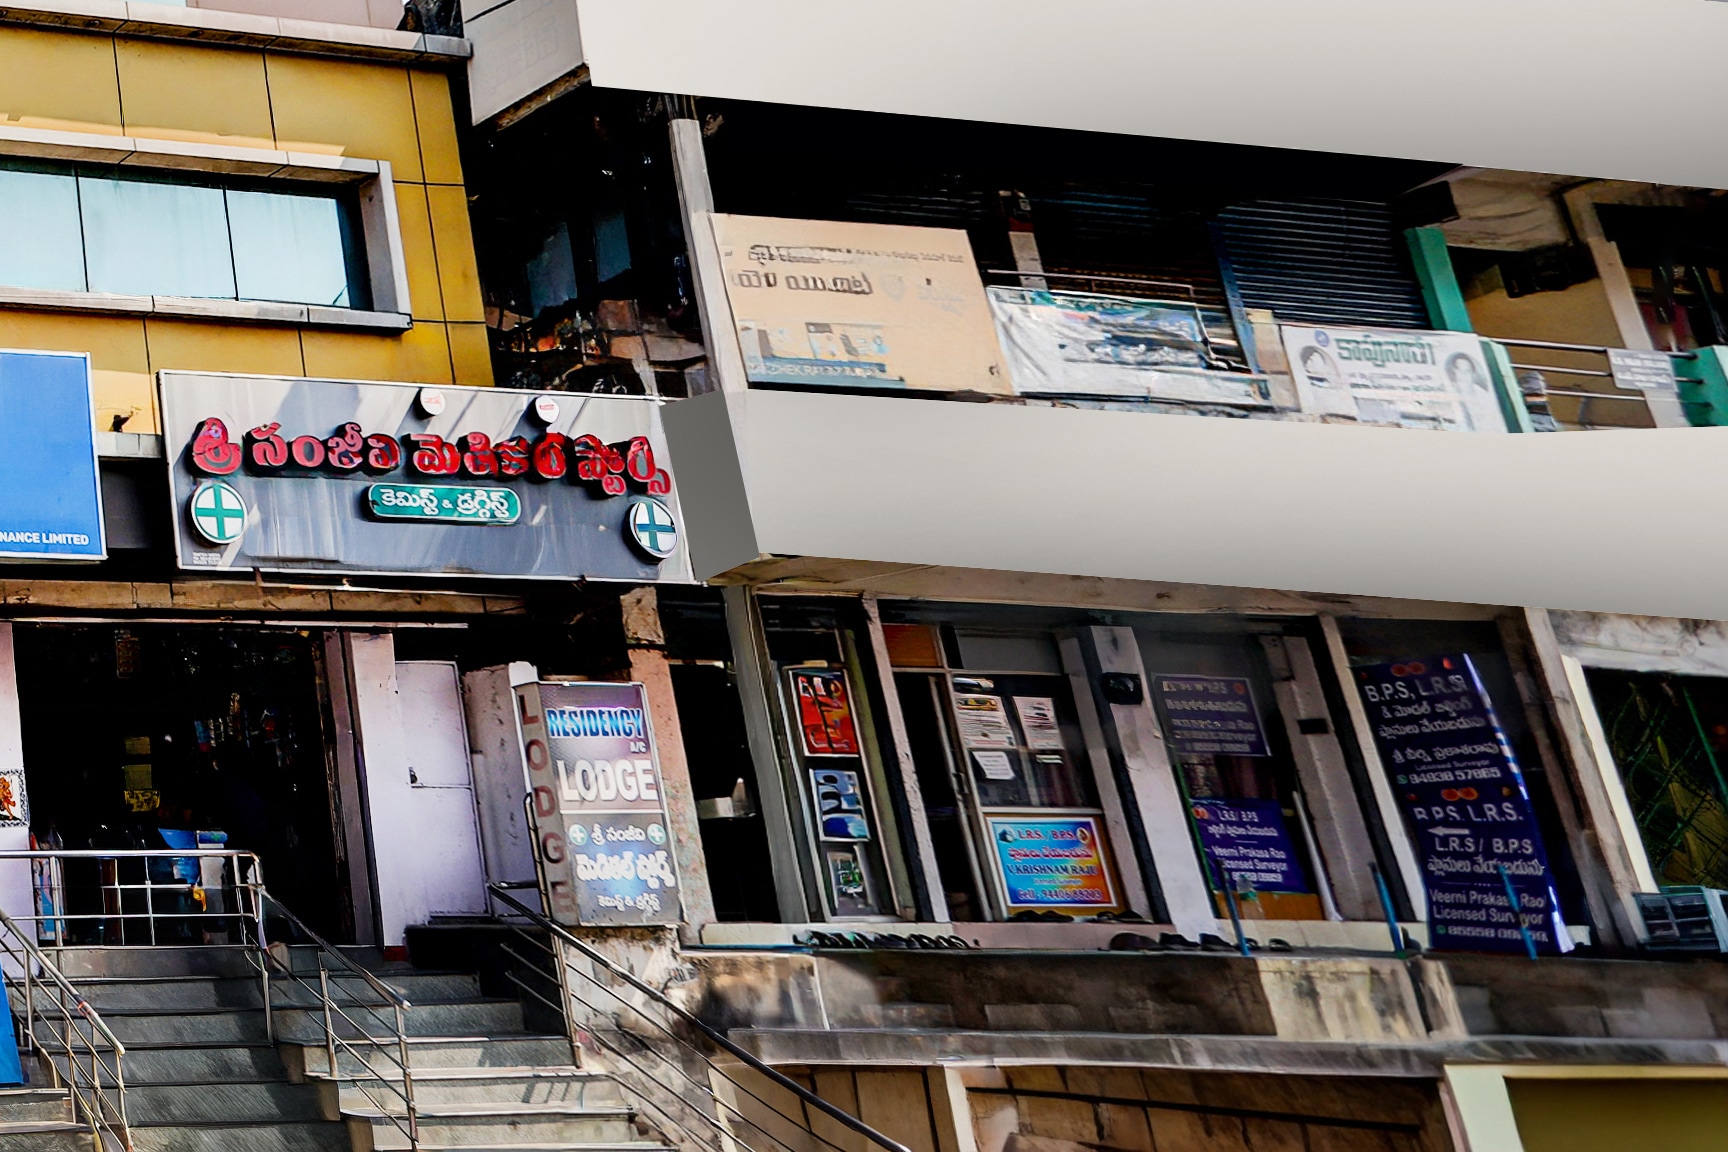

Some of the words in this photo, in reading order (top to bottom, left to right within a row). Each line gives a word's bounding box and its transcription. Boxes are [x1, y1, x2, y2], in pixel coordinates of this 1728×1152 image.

[380, 488, 439, 515] కెమిస్ట్
[442, 499, 454, 510] &
[42, 532, 89, 546] LIMITED
[546, 707, 645, 739] RESIDENCY
[556, 758, 659, 802] LODGE
[1467, 802, 1524, 822] L.R.S.
[1435, 836, 1475, 852] L.R.S
[1492, 838, 1534, 855] B.P.S
[1429, 889, 1467, 905] Veerni
[1469, 890, 1510, 907] Prakas
[1433, 905, 1487, 921] Licensed
